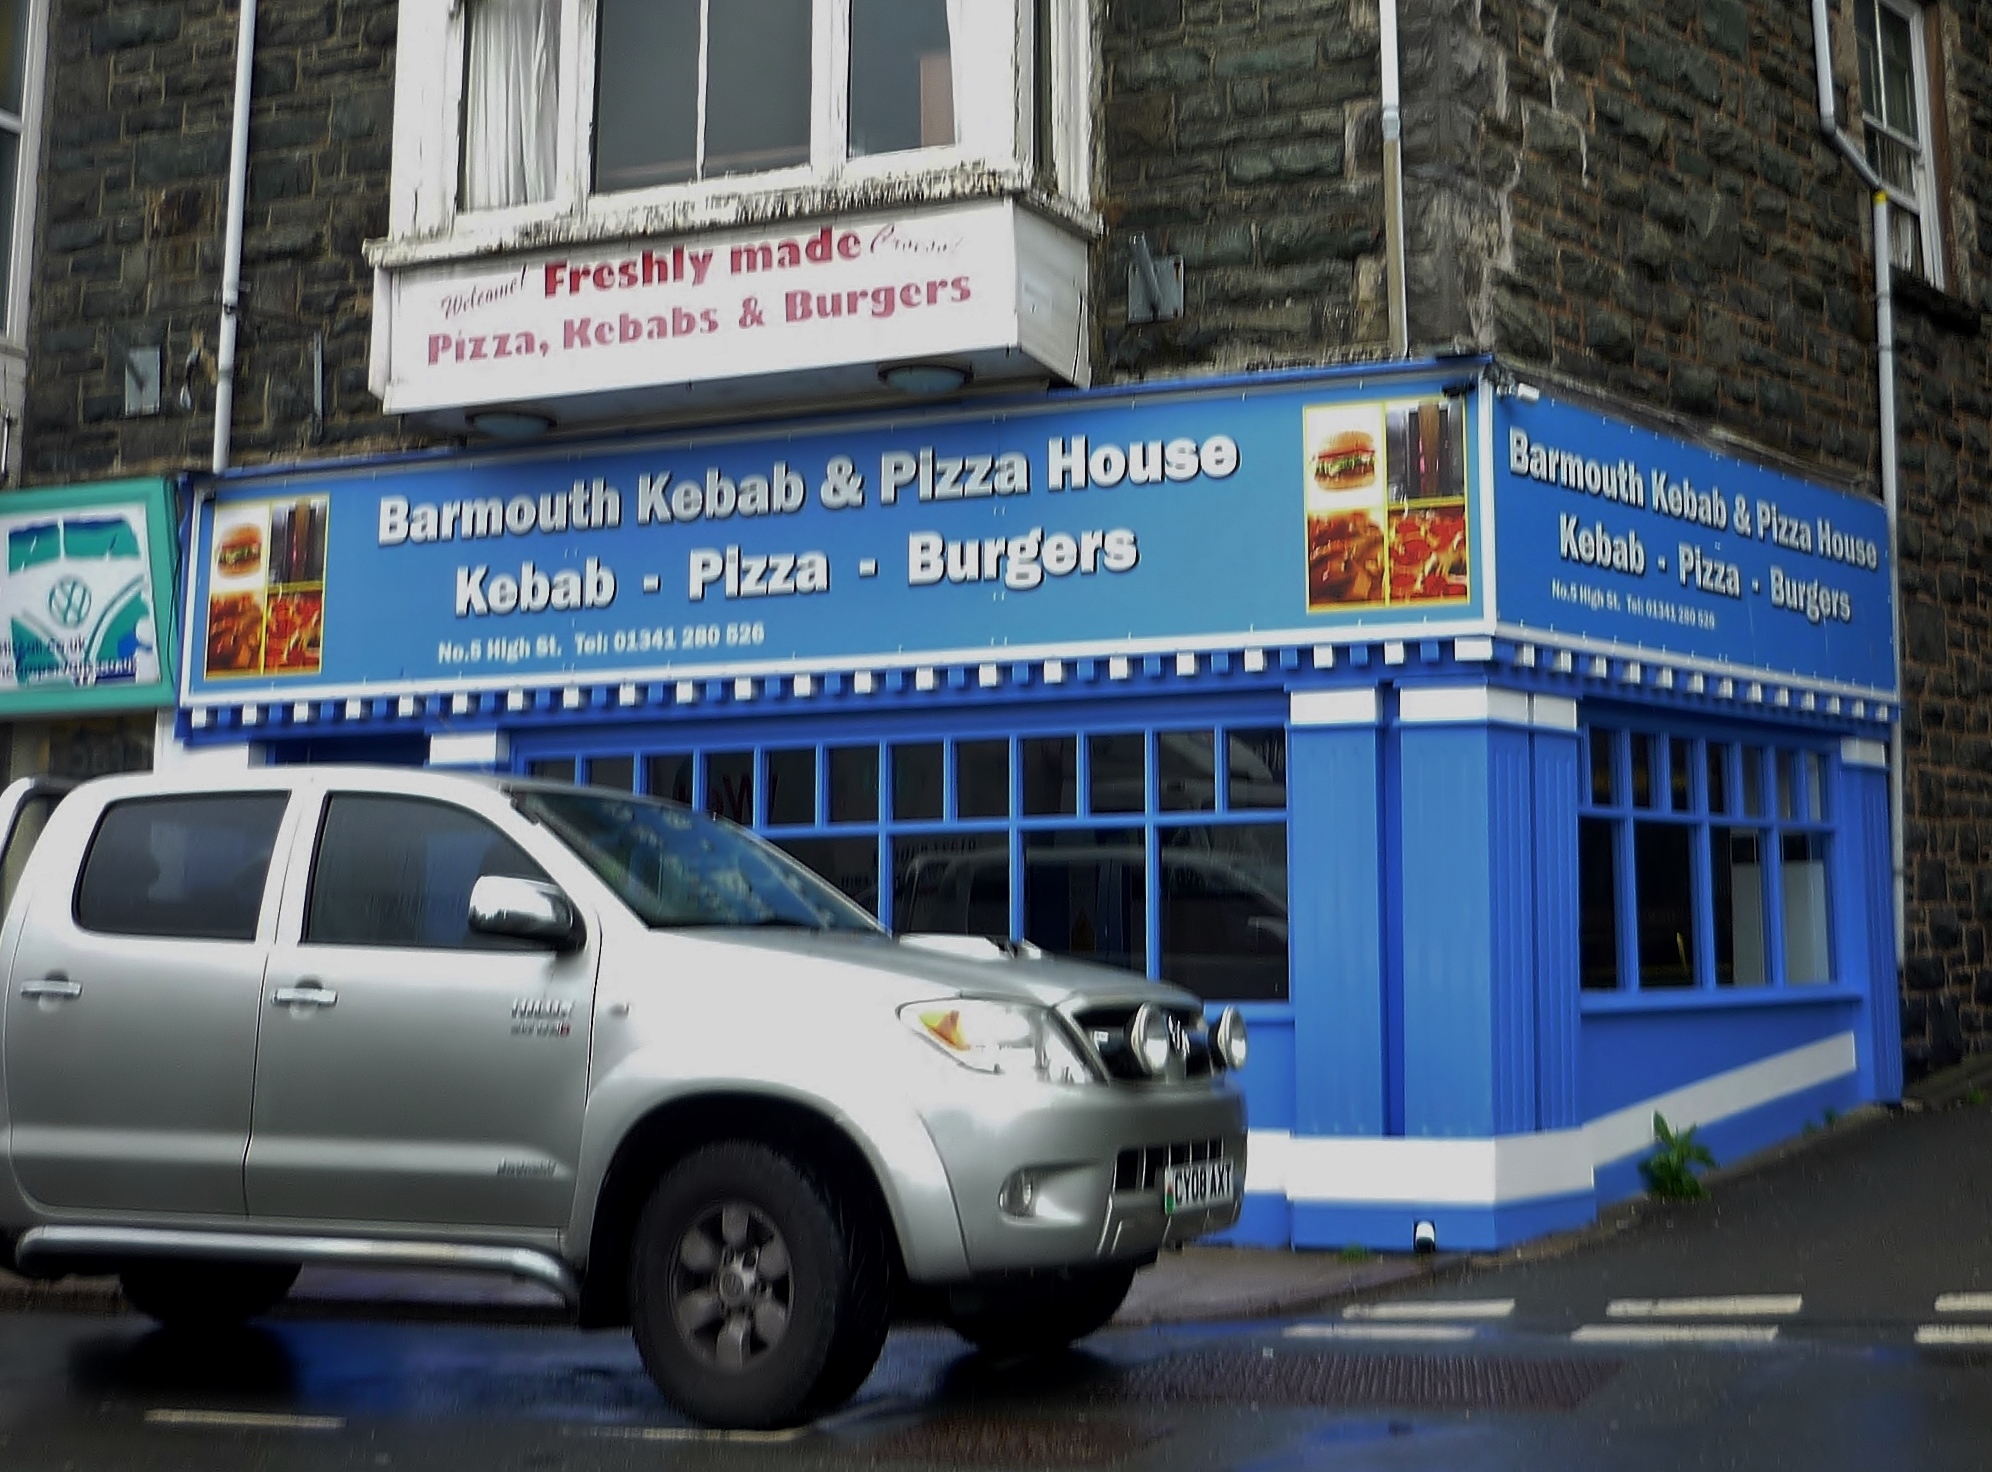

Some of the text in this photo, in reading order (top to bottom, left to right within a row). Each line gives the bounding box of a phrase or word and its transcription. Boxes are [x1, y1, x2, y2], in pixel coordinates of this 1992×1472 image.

[543, 248, 713, 298] Freshly
[729, 227, 861, 275] made
[427, 274, 972, 366] Pizza, Kebabs & Burgers
[379, 434, 1240, 546] Barmouth Kebab & Pizza House
[1509, 425, 1878, 571] Barmouth Kebab & Pizza House
[456, 526, 1139, 618] Kebab - Pizza - Burgers
[1559, 513, 1646, 577] Kebab
[1678, 541, 1741, 598] Pizza
[1770, 564, 1852, 624] Burgers
